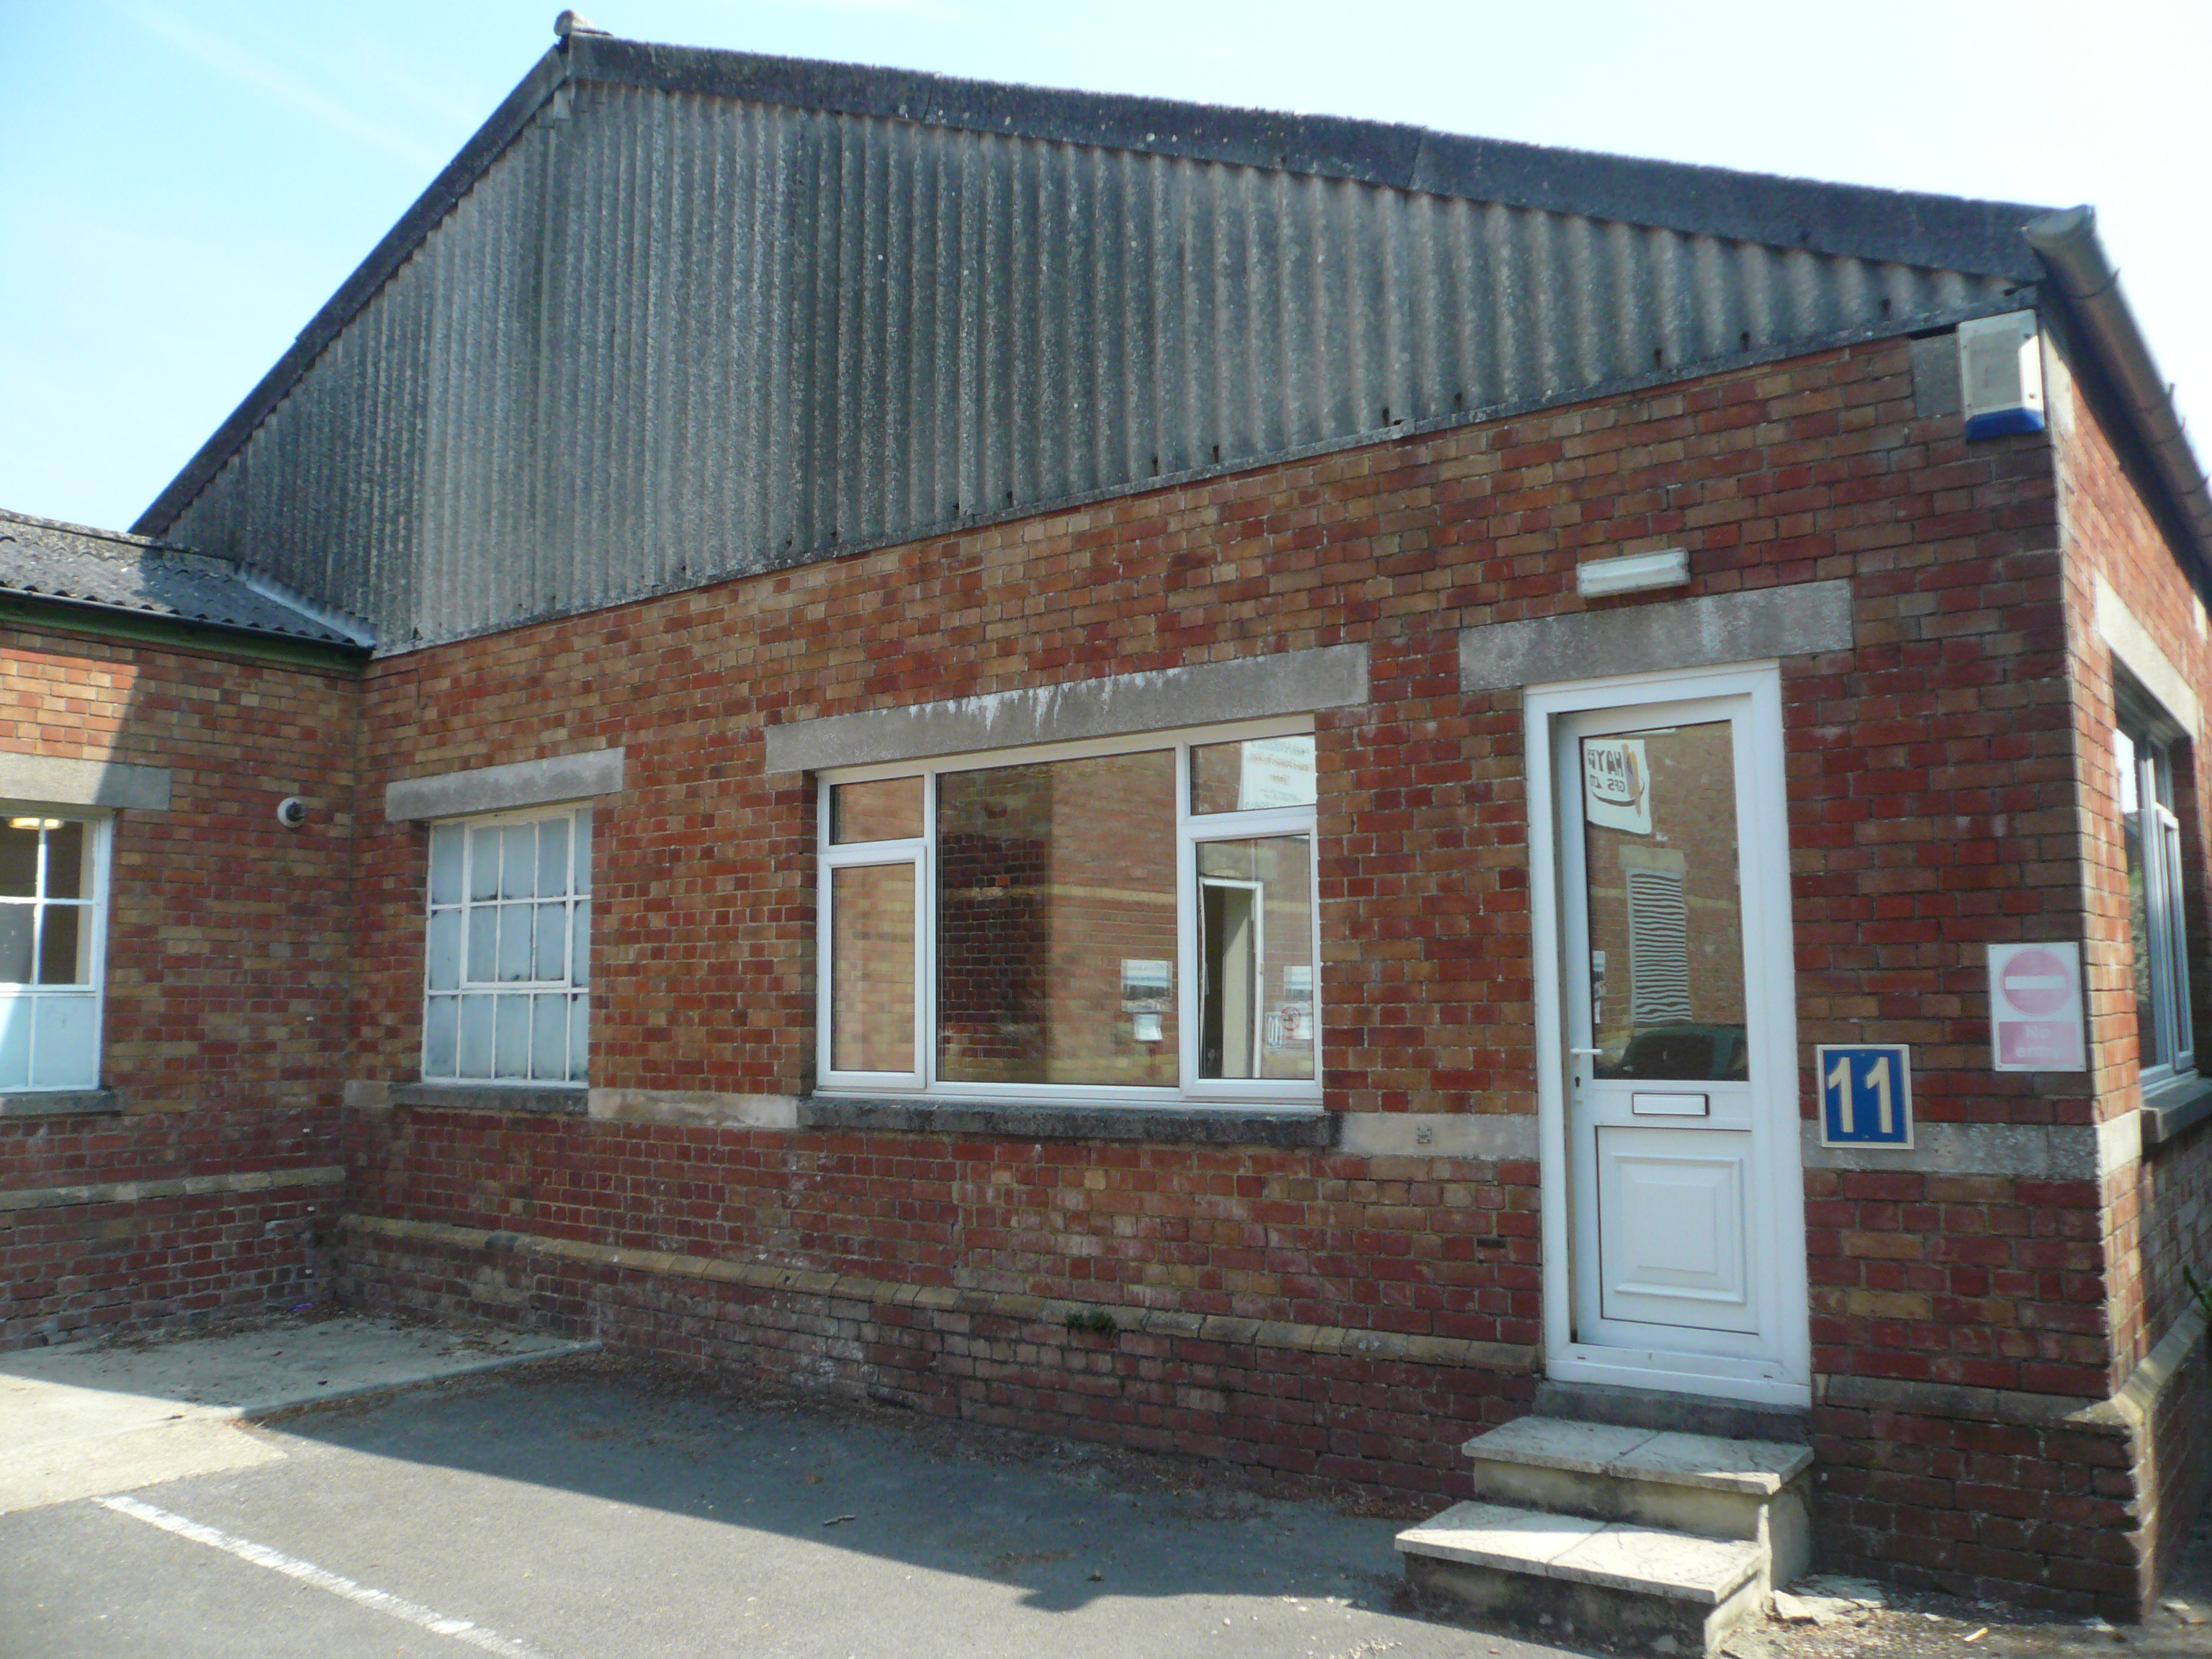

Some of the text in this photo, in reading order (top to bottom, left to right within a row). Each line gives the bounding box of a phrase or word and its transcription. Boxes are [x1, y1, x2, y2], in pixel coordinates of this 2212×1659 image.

[2026, 1025, 2051, 1038] No
[2016, 1043, 2064, 1061] entry
[1827, 1056, 1893, 1133] 11
